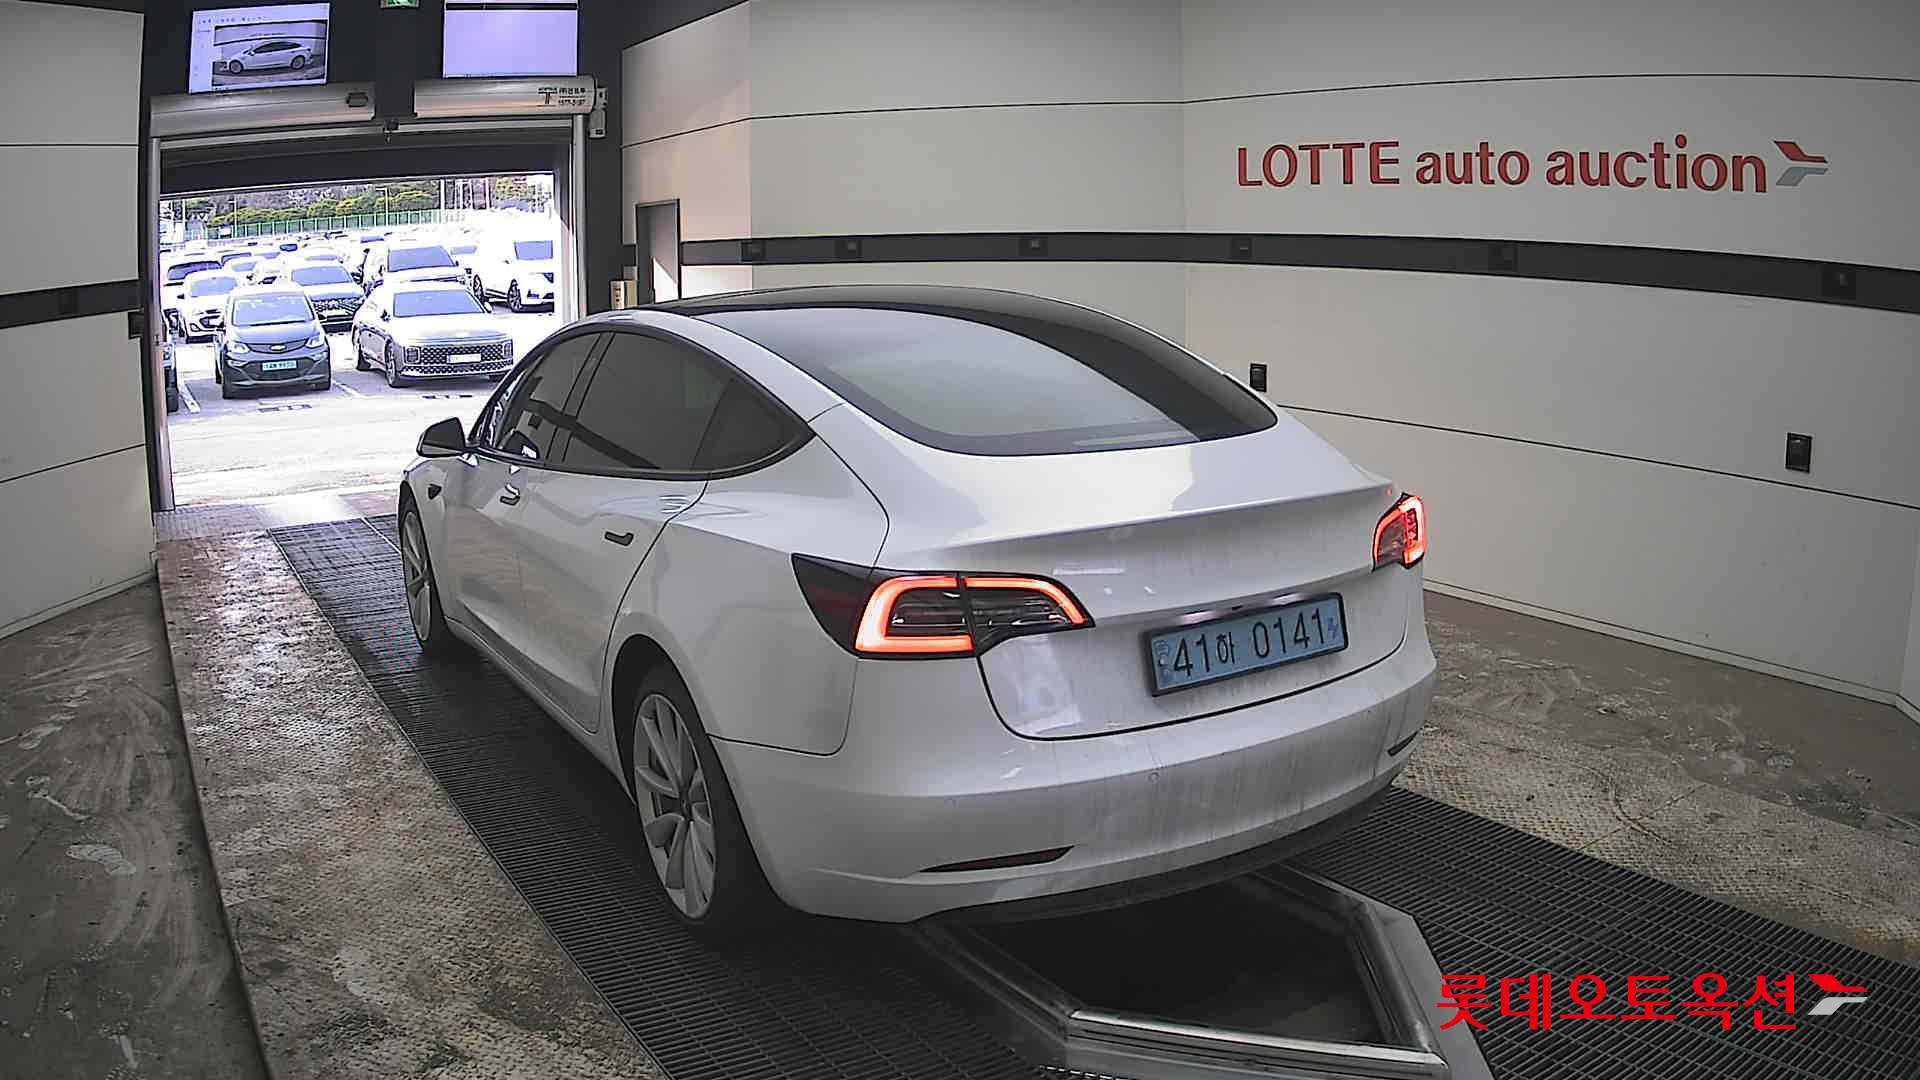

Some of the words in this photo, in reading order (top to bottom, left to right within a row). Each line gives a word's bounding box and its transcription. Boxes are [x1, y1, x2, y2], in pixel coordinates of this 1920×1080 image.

[1236, 140, 1400, 188] LOTTE
[1415, 141, 1531, 187] auto
[1545, 134, 1768, 194] auction
[1173, 631, 1236, 677] 41하
[1252, 607, 1325, 659] 0141
